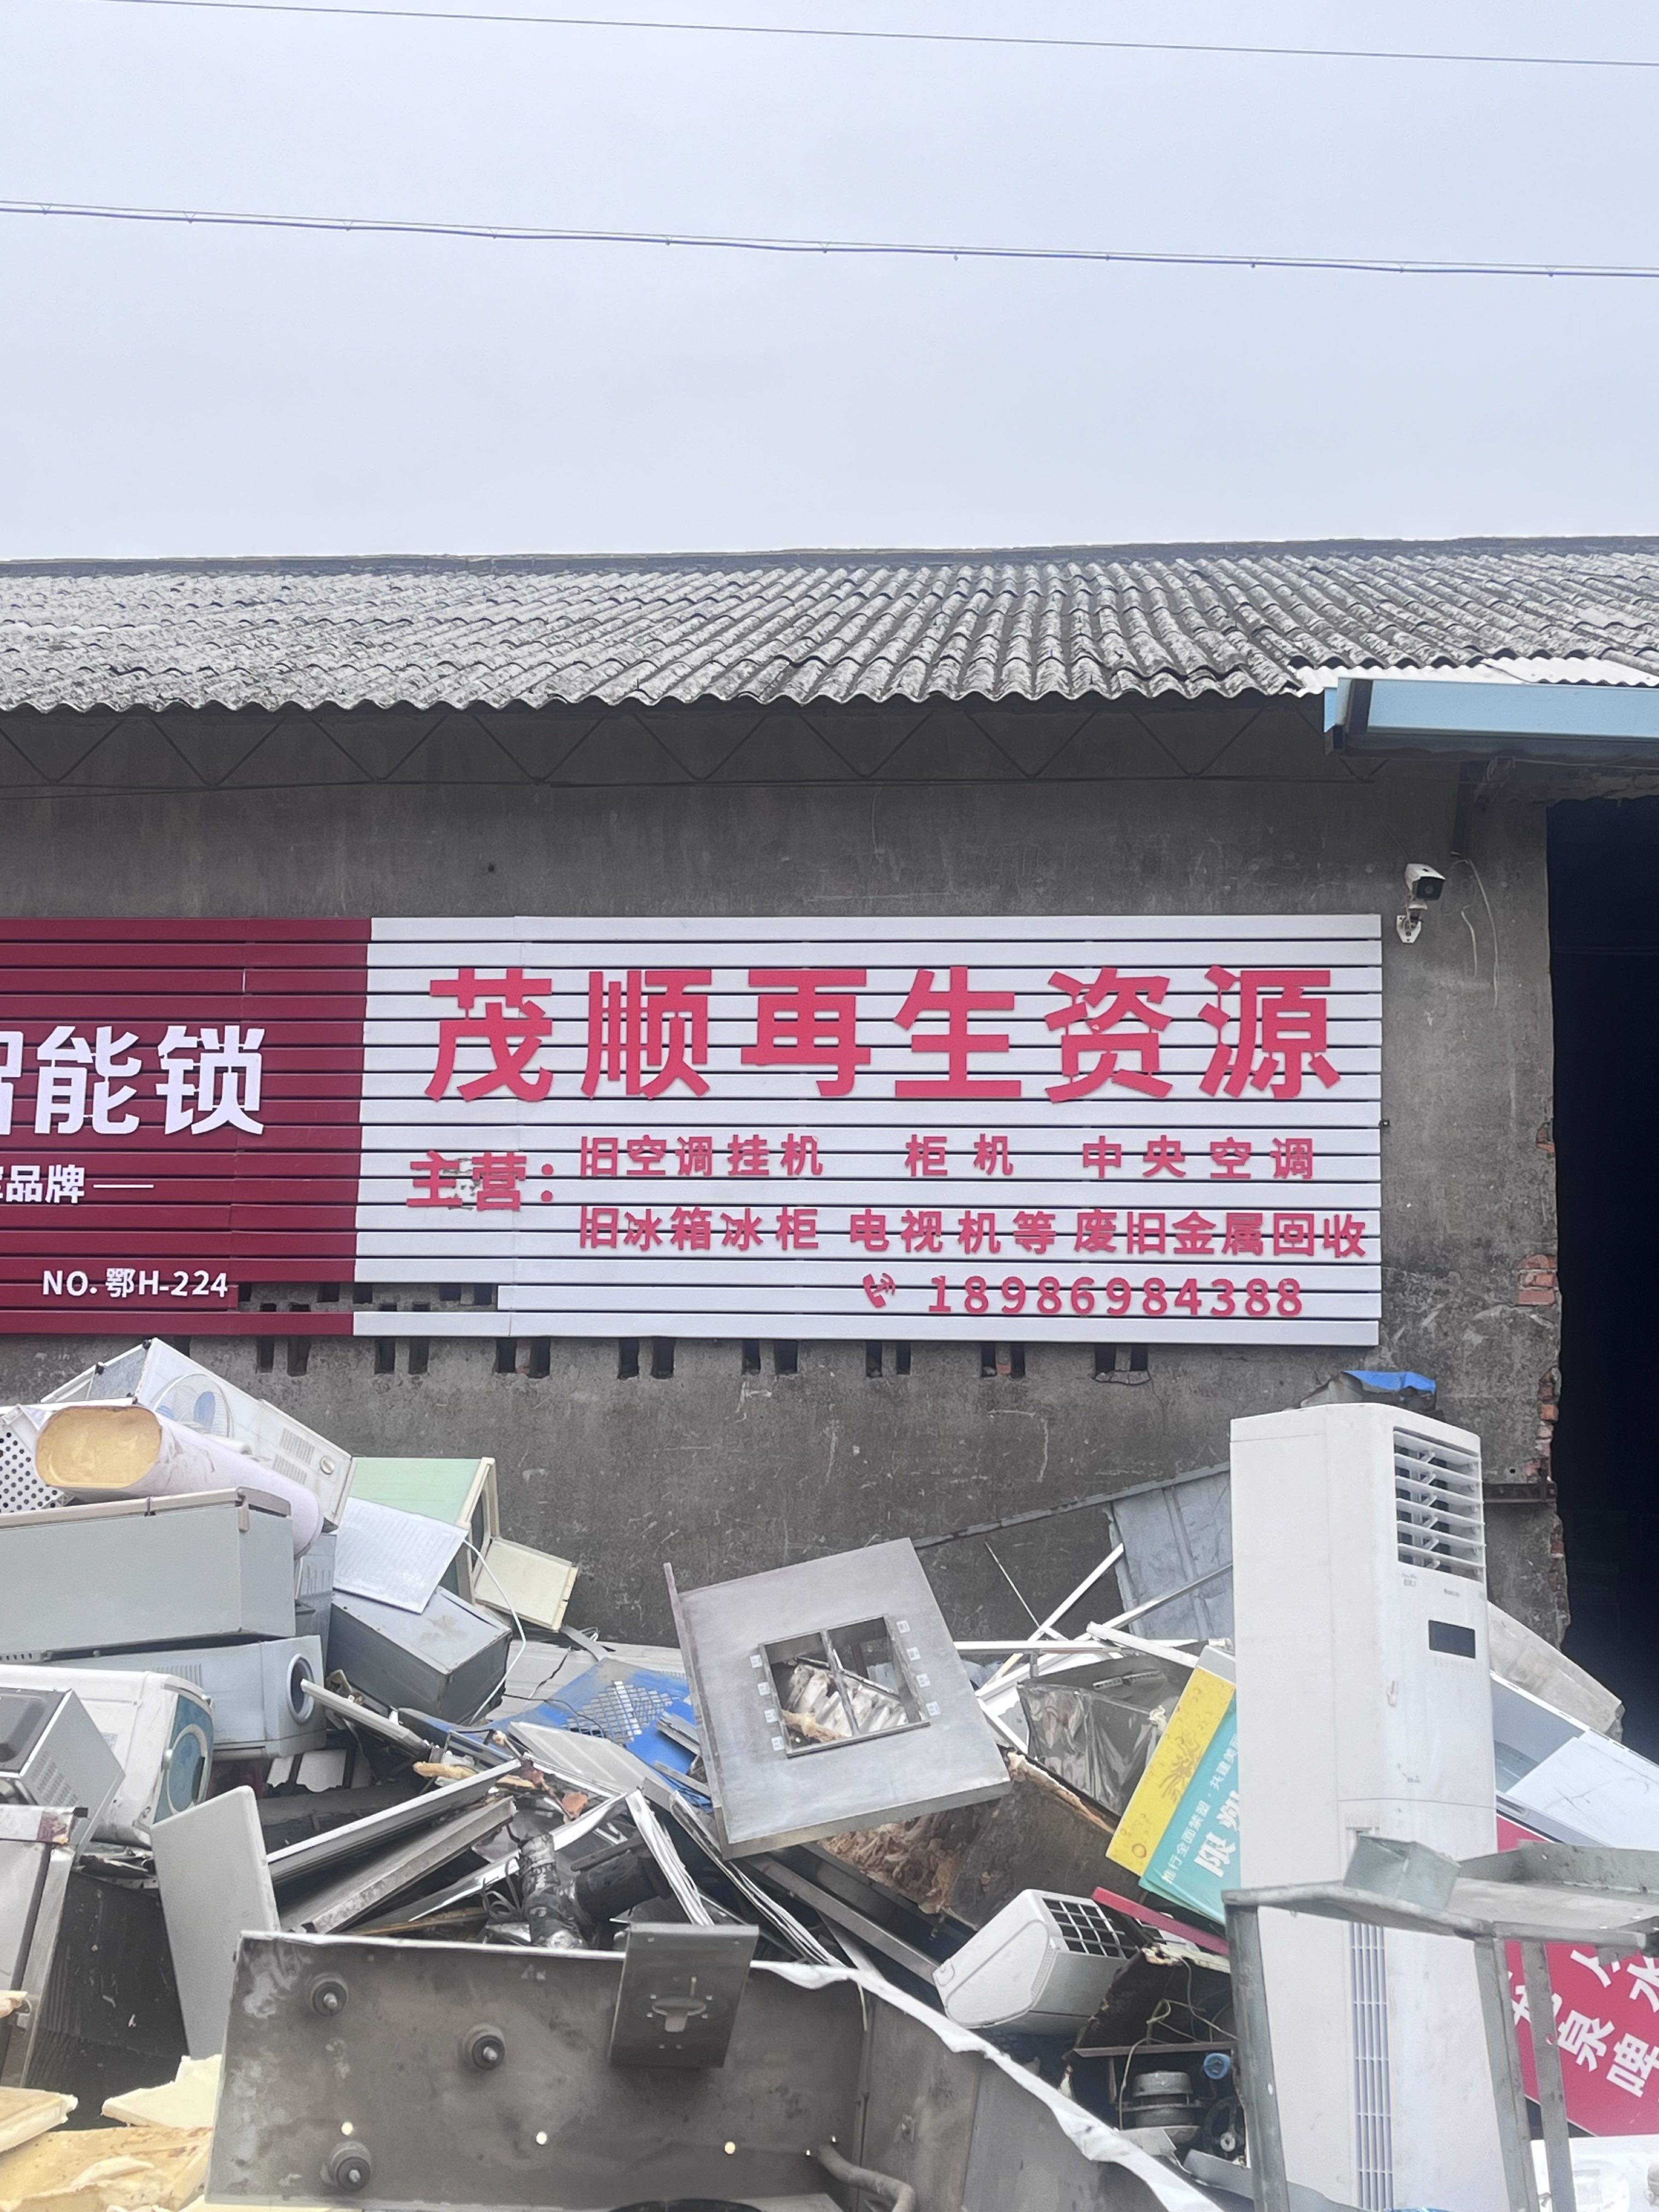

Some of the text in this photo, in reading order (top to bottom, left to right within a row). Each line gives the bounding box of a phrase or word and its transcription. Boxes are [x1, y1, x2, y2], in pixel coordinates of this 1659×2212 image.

[425, 965, 1341, 1103] 茂顺再生资源
[580, 1133, 1313, 1180] 旧空调挂机 柜机 中央空调
[0, 1164, 84, 1203] 品牌
[406, 1150, 553, 1211] 主营：
[580, 1206, 1365, 1257] 旧冰箱冰柜 电视机等废旧金属回收
[43, 1268, 228, 1298] NO. 鄂H-224
[929, 1275, 1303, 1317] 18986984388
